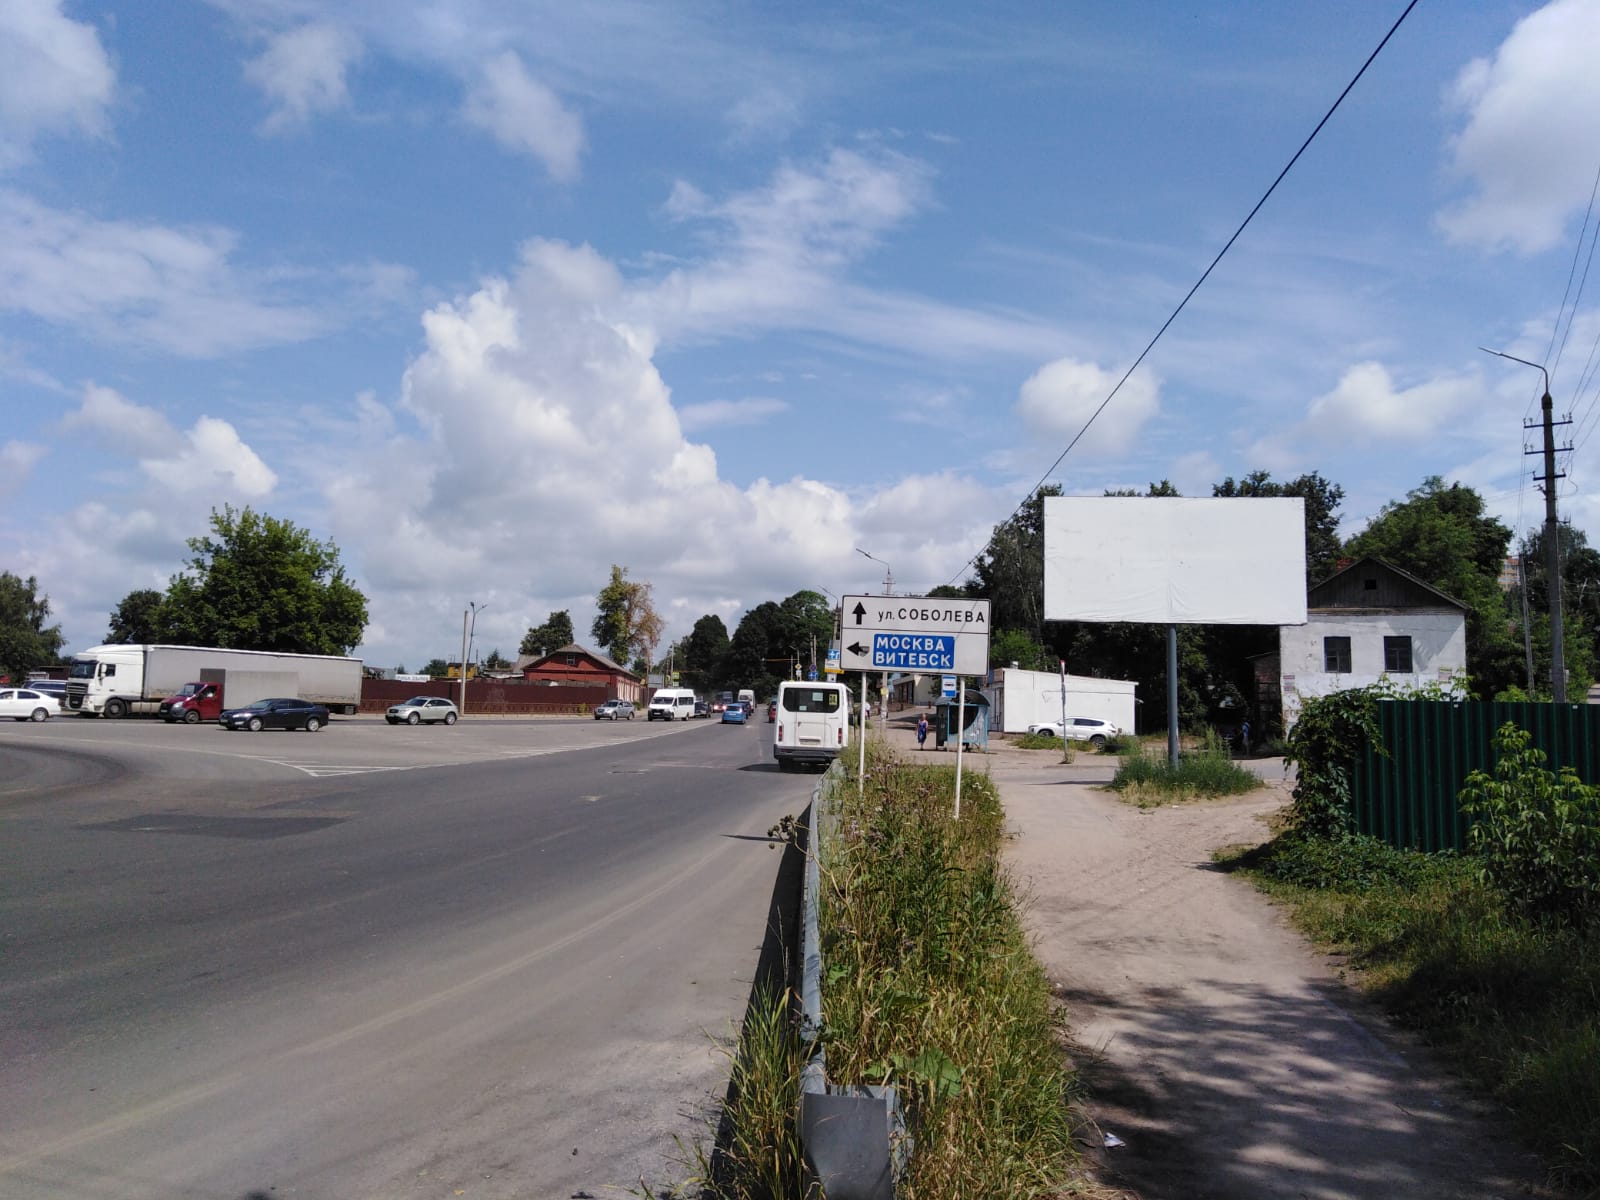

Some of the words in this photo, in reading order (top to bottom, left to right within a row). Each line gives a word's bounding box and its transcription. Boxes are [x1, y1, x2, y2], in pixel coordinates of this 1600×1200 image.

[878, 611, 895, 622] ул.
[898, 608, 985, 622] СОБОЛЕВА
[876, 636, 945, 651] МОСКВА
[875, 651, 951, 667] ВИТЕБСК
